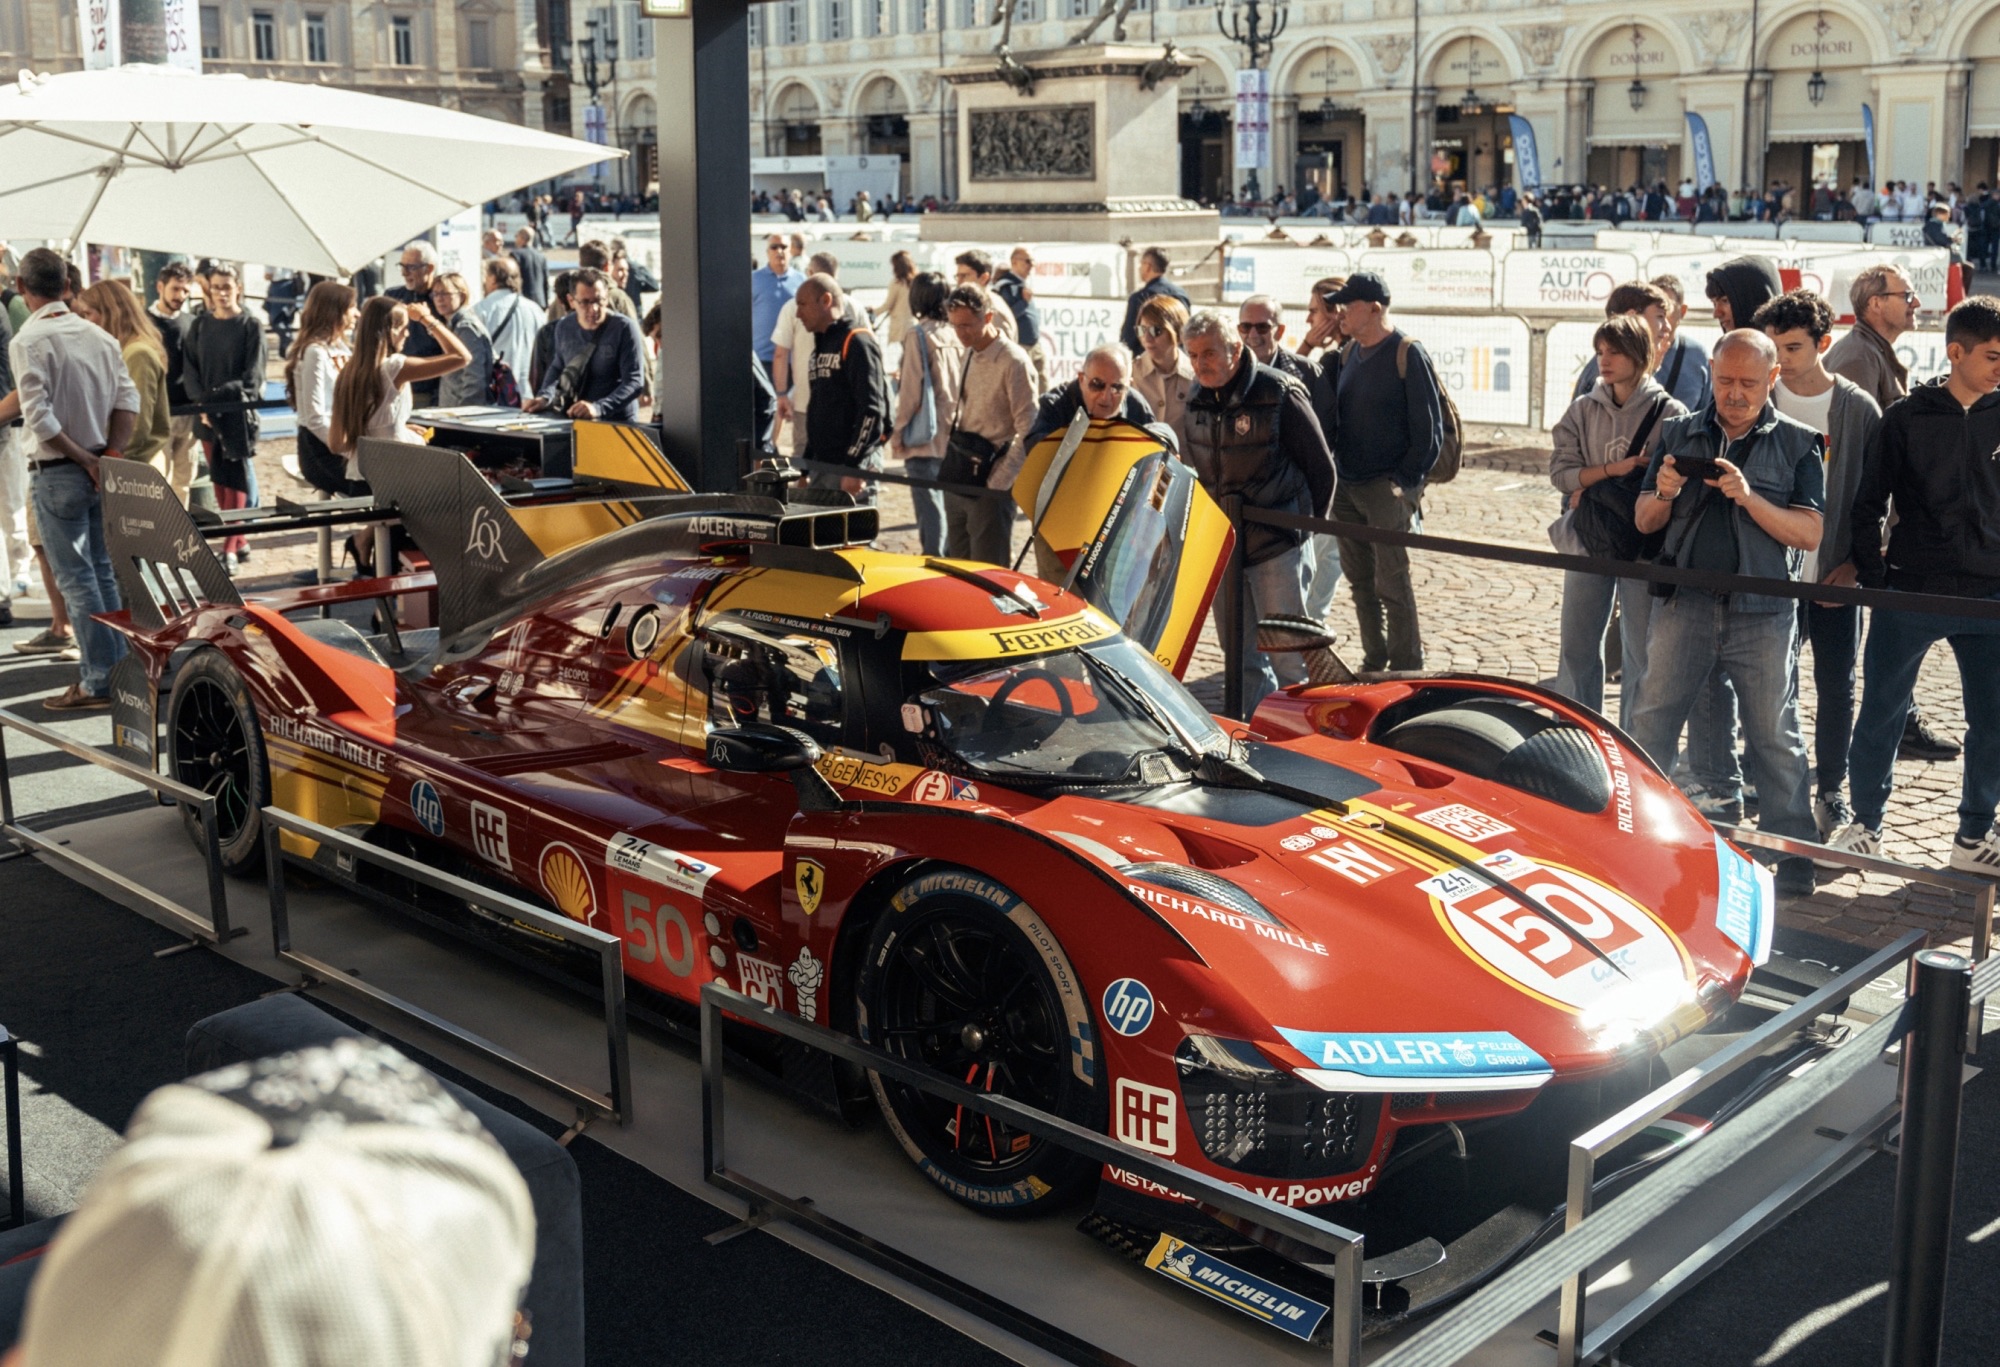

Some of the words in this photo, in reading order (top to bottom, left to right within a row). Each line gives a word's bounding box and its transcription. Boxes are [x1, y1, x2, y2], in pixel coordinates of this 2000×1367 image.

[1610, 51, 1665, 66] DOMORI
[1791, 41, 1852, 56] DOMORI
[1450, 59, 1500, 71] BREITLING
[1890, 227, 1921, 239] SALO
[1224, 264, 1252, 283] Rai
[1540, 256, 1605, 269] SALONE
[116, 475, 165, 500] Santander
[687, 516, 734, 537] ADLER
[563, 667, 590, 682] ECOPOL
[268, 714, 335, 752] RICHARD
[338, 738, 387, 773] MILLE
[831, 761, 901, 793] GENESYS
[1420, 804, 1475, 826] HYPER
[1612, 771, 1634, 834] RICHARD
[1447, 814, 1504, 840] CAR
[613, 855, 622, 863] LE
[622, 857, 641, 870] MANS
[1307, 841, 1396, 885] HY
[919, 875, 1011, 907] MICHELIN
[1431, 872, 1472, 895] 24h
[1128, 884, 1246, 930] RICHARD
[1253, 922, 1330, 957] MILLE
[1472, 882, 1614, 964] 50
[1726, 886, 1751, 947] ADLER
[621, 888, 695, 978] 50
[741, 957, 783, 988] HYPE
[1028, 922, 1052, 953] PILOT
[1050, 955, 1074, 997] SPORT
[745, 979, 782, 1010] CA
[1322, 1040, 1449, 1065] ADLER
[1477, 1041, 1523, 1051] PELZER
[1484, 1053, 1530, 1066] GROUP
[926, 1164, 1015, 1204] MICHELIN
[1255, 1172, 1373, 1207] V-Power
[1194, 1266, 1306, 1321] MICHELIN
